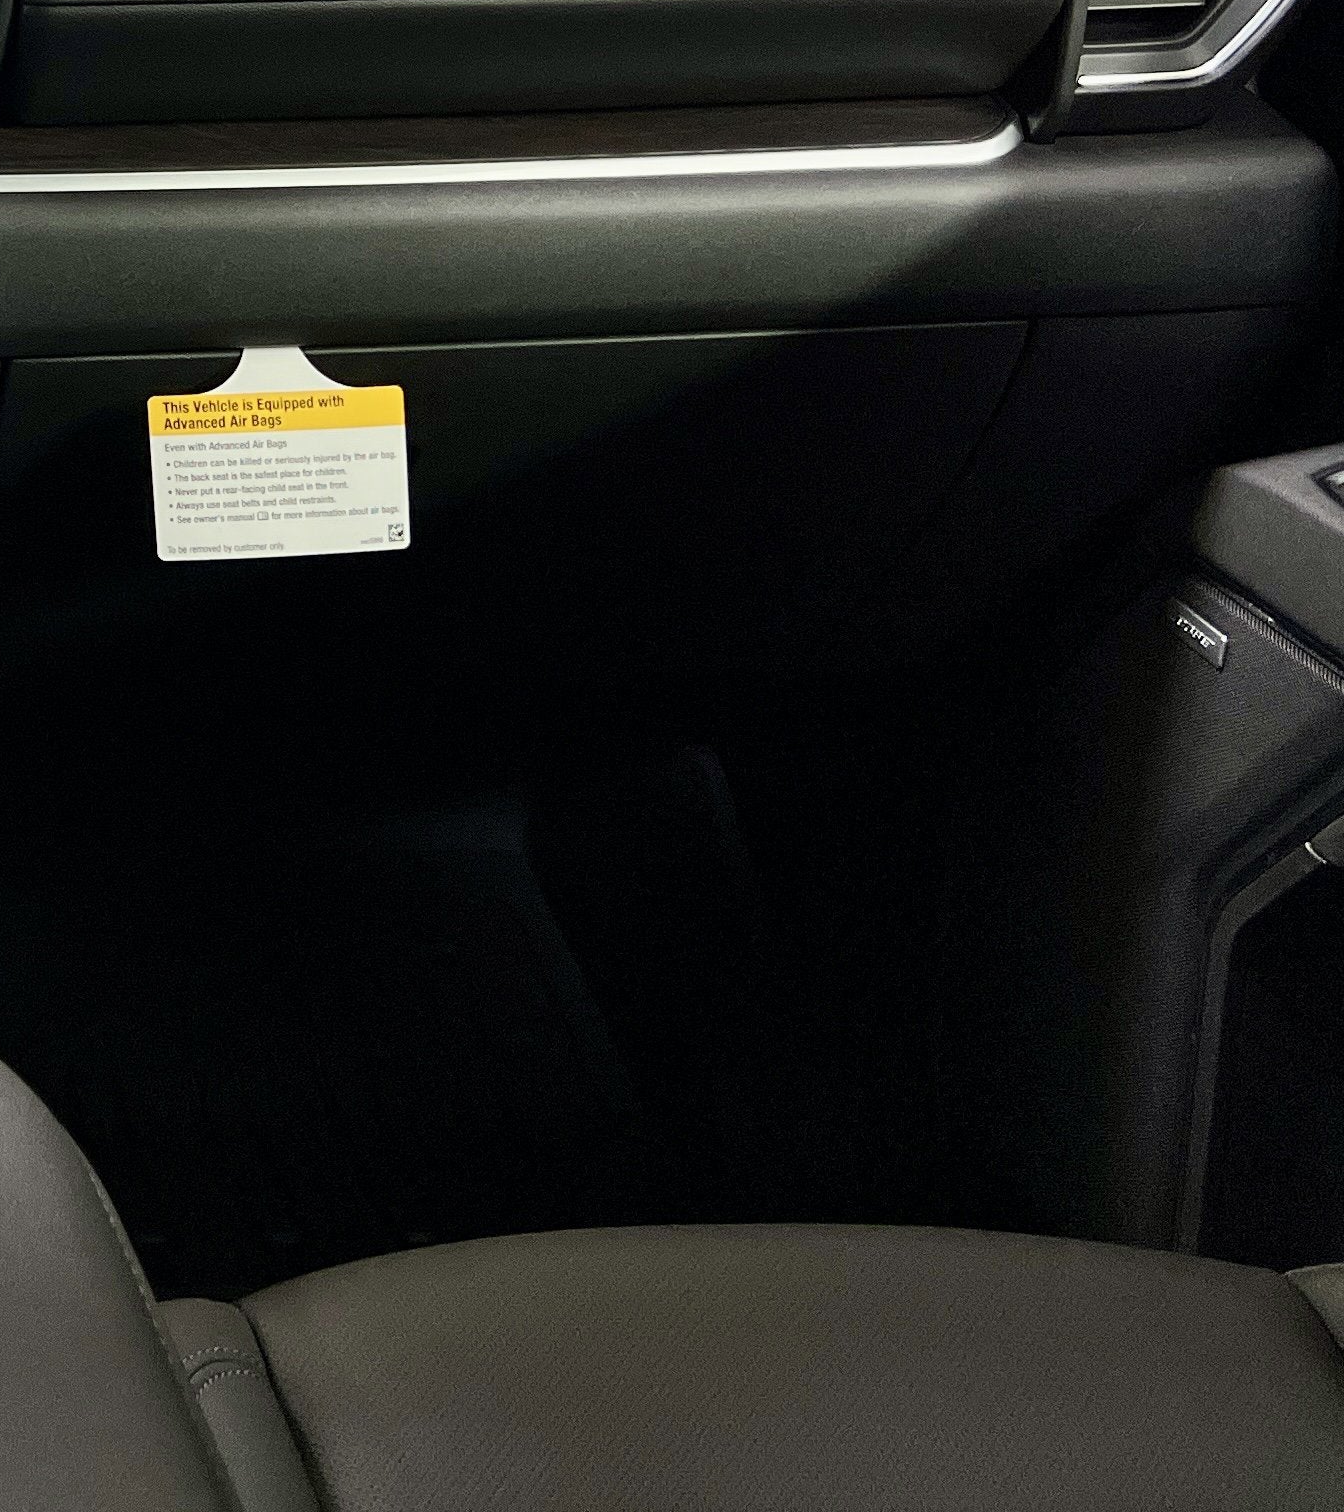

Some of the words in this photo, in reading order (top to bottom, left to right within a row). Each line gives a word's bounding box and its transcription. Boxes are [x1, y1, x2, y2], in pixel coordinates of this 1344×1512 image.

[164, 401, 189, 414] This
[193, 399, 238, 413] Vehicle
[243, 399, 253, 411] is
[257, 397, 314, 412] Equipped
[318, 395, 344, 407] with
[164, 416, 225, 430] Advanced
[230, 416, 247, 427] Air
[252, 415, 282, 428] Bags
[164, 443, 185, 452] Even
[188, 442, 206, 451] with
[209, 441, 250, 451] Advanced
[253, 440, 264, 448] Air
[267, 439, 288, 449] Bags
[173, 460, 207, 468] Children
[228, 458, 237, 466] be
[240, 457, 261, 465] killed
[275, 455, 310, 465] seriously
[313, 453, 340, 464] injured
[343, 452, 351, 462] by
[175, 474, 188, 482] The
[191, 473, 209, 481] back
[280, 470, 300, 479] place
[302, 469, 312, 477] for
[175, 488, 197, 496] Never
[177, 515, 191, 523] See
[167, 546, 176, 554] To
[178, 545, 187, 553] be
[190, 544, 221, 553] removed
[223, 544, 232, 554] by
[234, 543, 267, 551] customer
